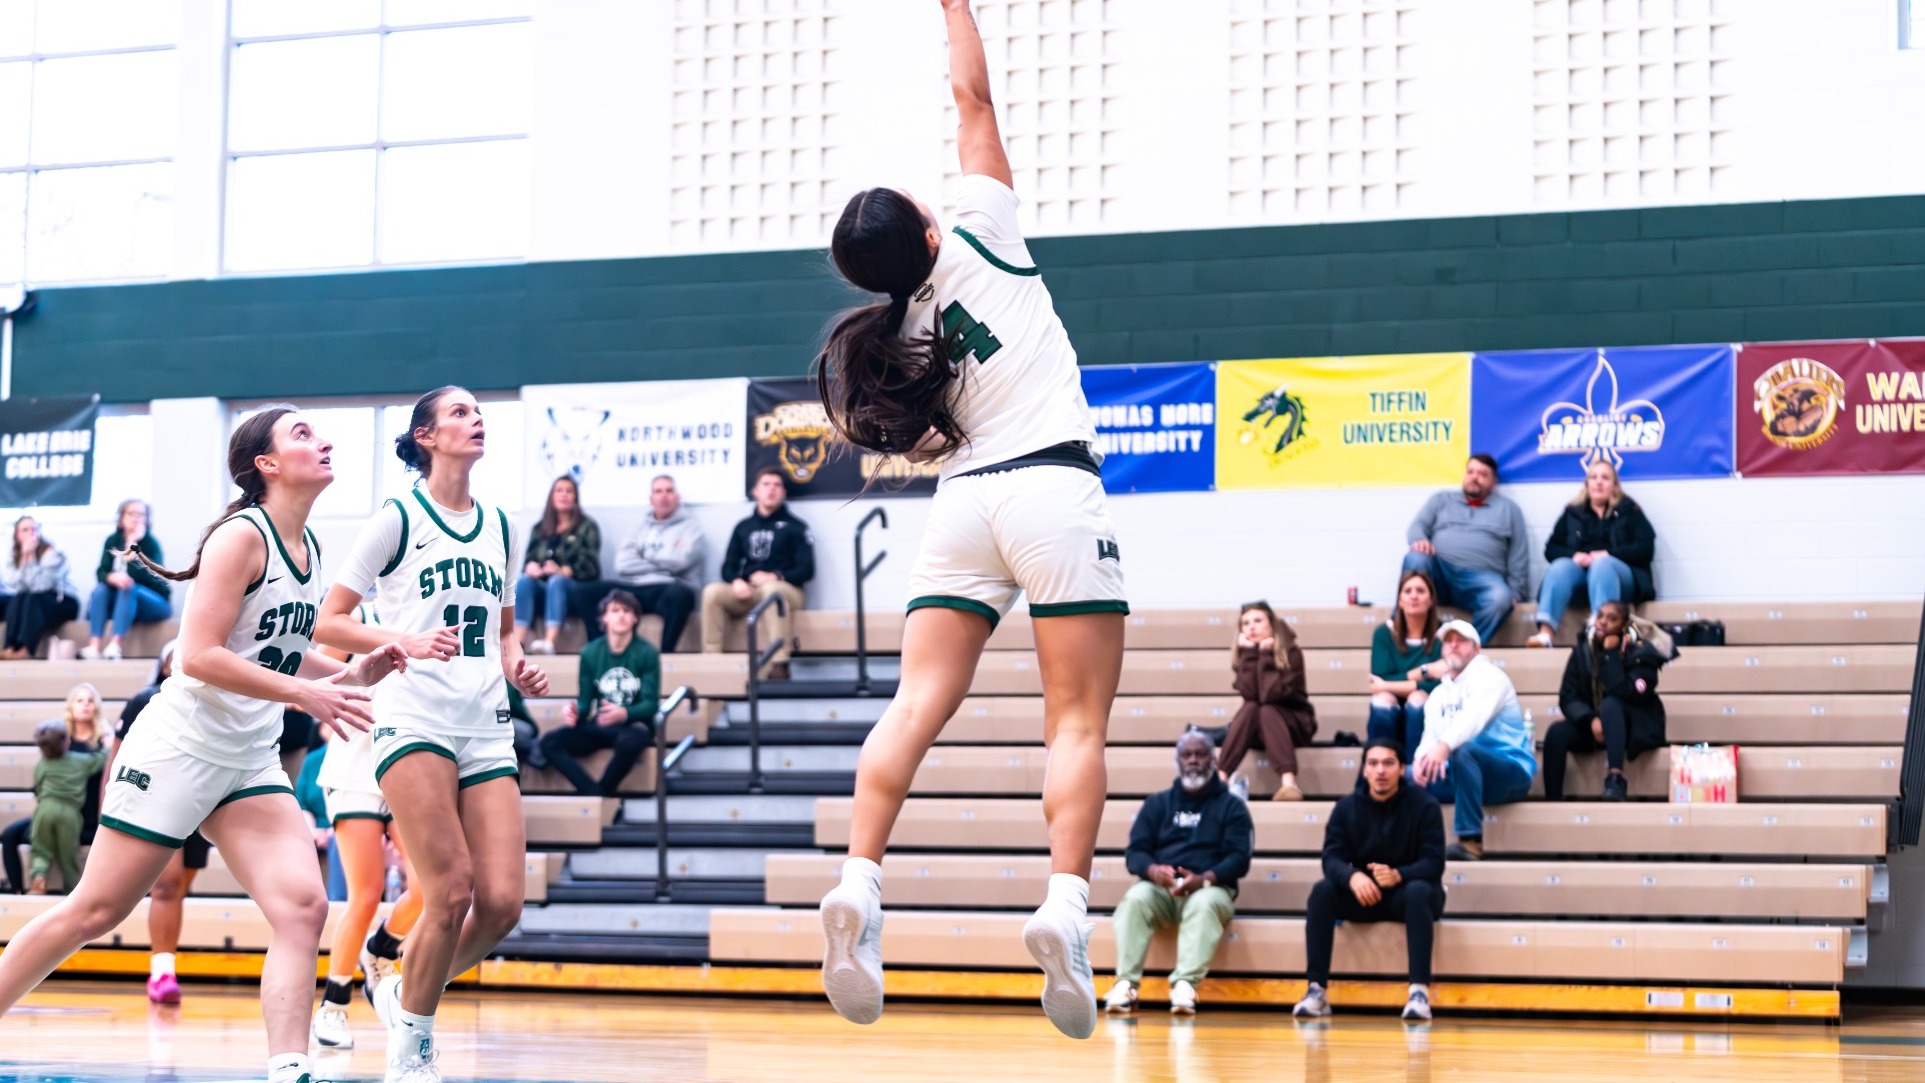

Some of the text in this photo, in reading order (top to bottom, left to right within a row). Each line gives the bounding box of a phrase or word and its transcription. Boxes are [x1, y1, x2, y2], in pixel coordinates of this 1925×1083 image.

[1866, 371, 1925, 401] WA
[1088, 402, 1214, 428] HOMAS MORE
[1369, 391, 1427, 413] TIFFIN
[1, 429, 91, 456] LAKE ERIE
[617, 423, 733, 442] NORTHWOOD
[1097, 430, 1204, 455] NIVERSITY
[1343, 420, 1453, 444] UNIVERSITY
[1543, 421, 1661, 449] ARROWS
[5, 454, 84, 479] COLLEGE
[616, 448, 730, 467] UNIVERSITY
[419, 556, 503, 604] STORM
[254, 601, 318, 641] STOR
[443, 604, 488, 657] 12
[114, 764, 152, 792] LEC
